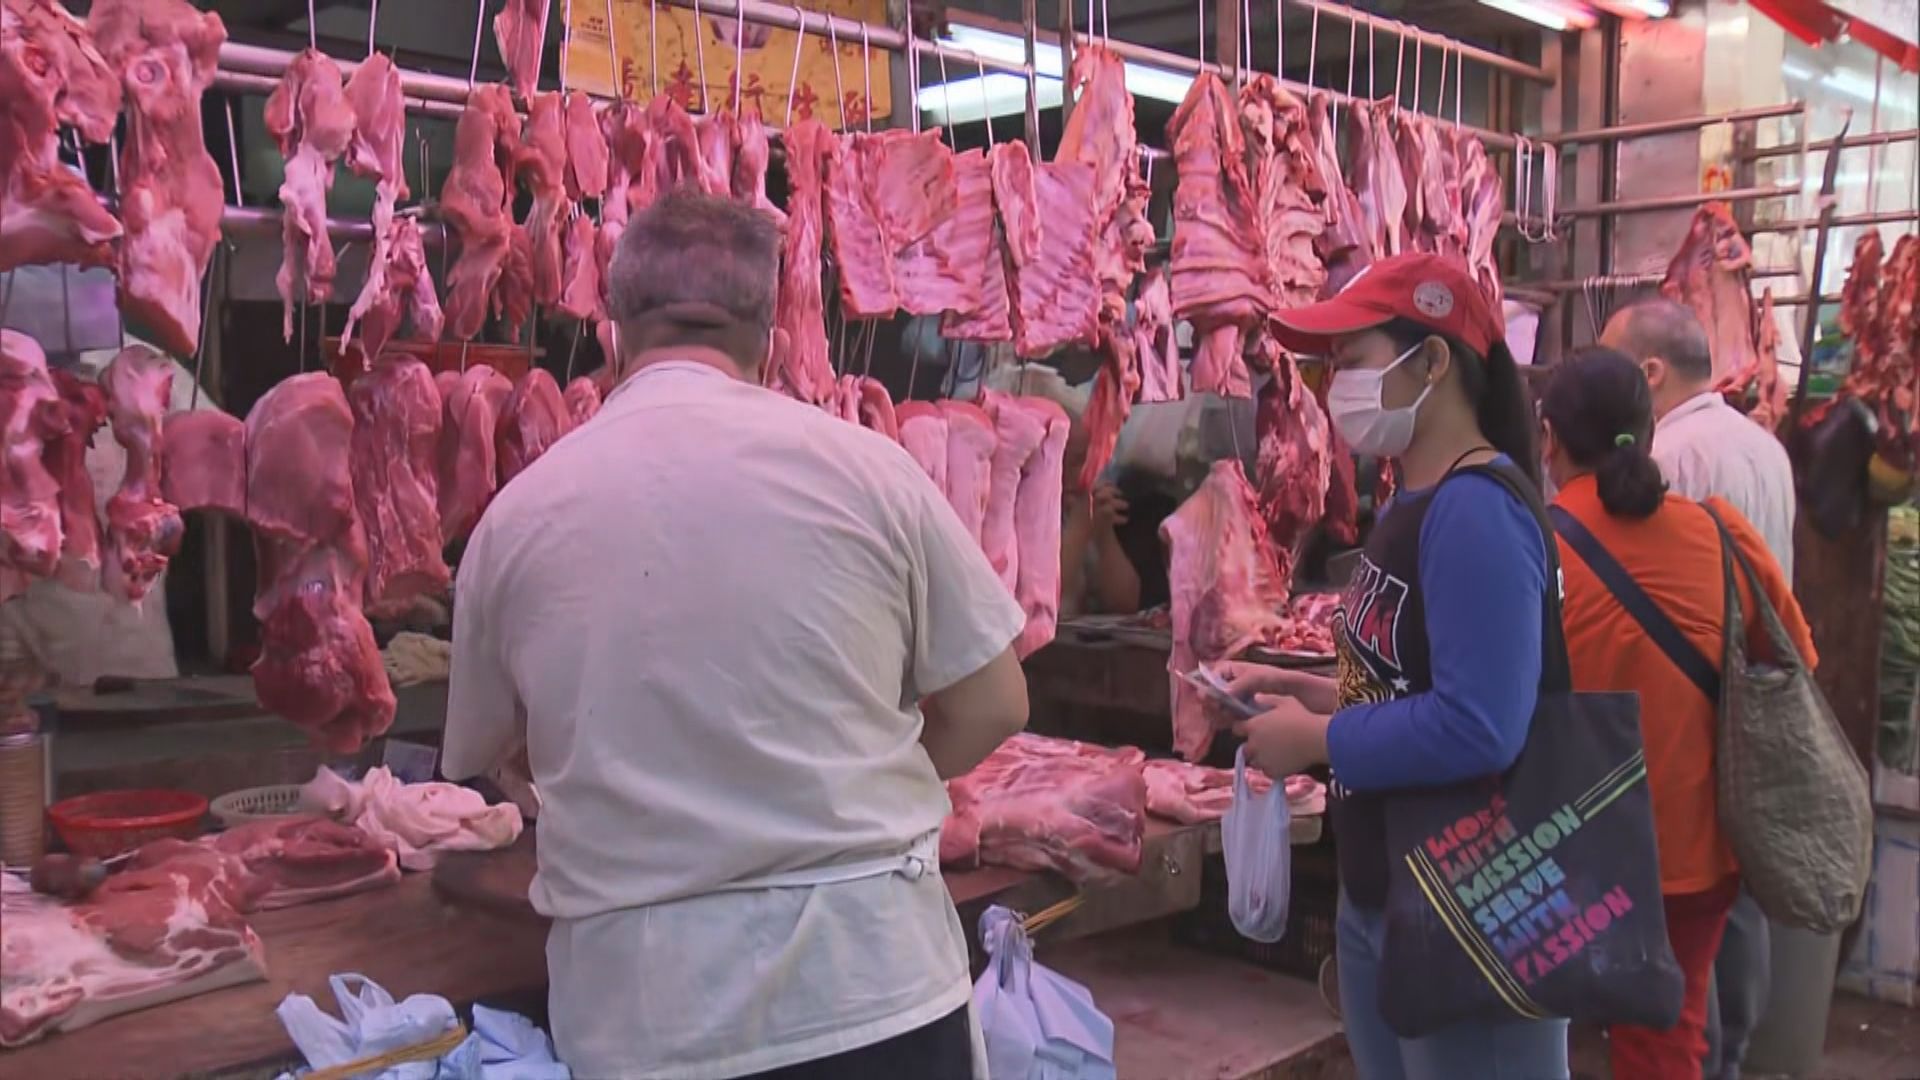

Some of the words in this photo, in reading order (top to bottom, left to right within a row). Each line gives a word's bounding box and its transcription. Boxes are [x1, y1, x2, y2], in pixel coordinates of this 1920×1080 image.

[1439, 814, 1518, 884] WITH
[1455, 804, 1582, 909] MISSION
[1473, 857, 1566, 934] SERVE
[1492, 888, 1576, 958] WITH
[1514, 884, 1633, 985] PASSION
